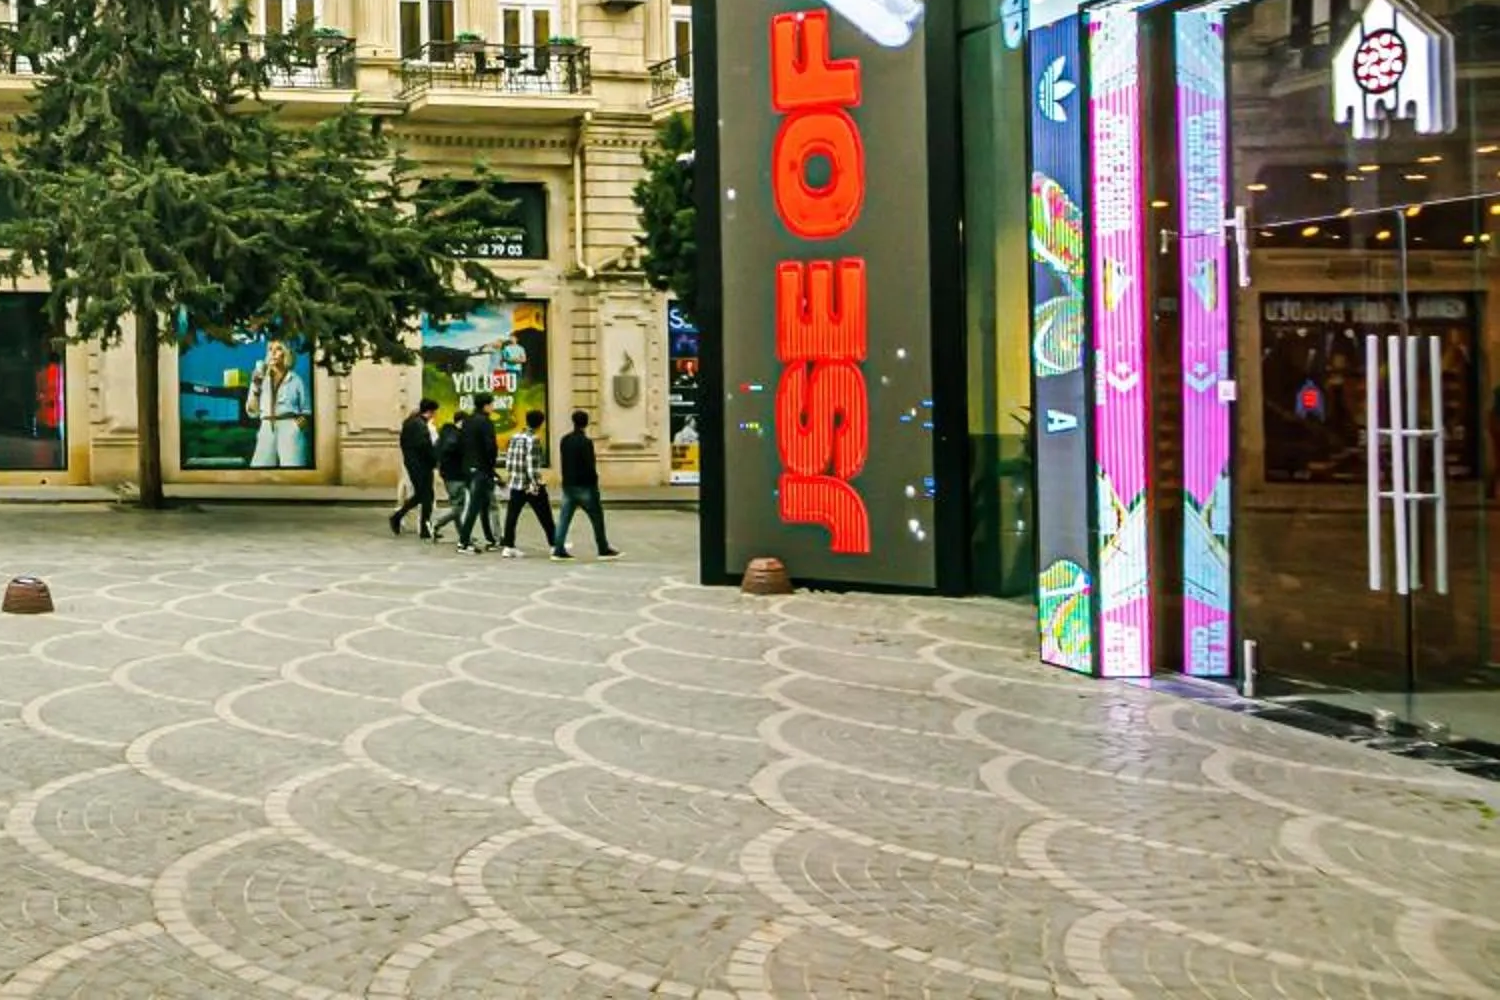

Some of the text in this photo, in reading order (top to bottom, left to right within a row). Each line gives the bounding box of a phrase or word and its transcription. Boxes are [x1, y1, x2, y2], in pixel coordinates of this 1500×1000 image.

[770, 8, 866, 241] OF
[491, 244, 505, 256] 79
[507, 244, 523, 257] 03
